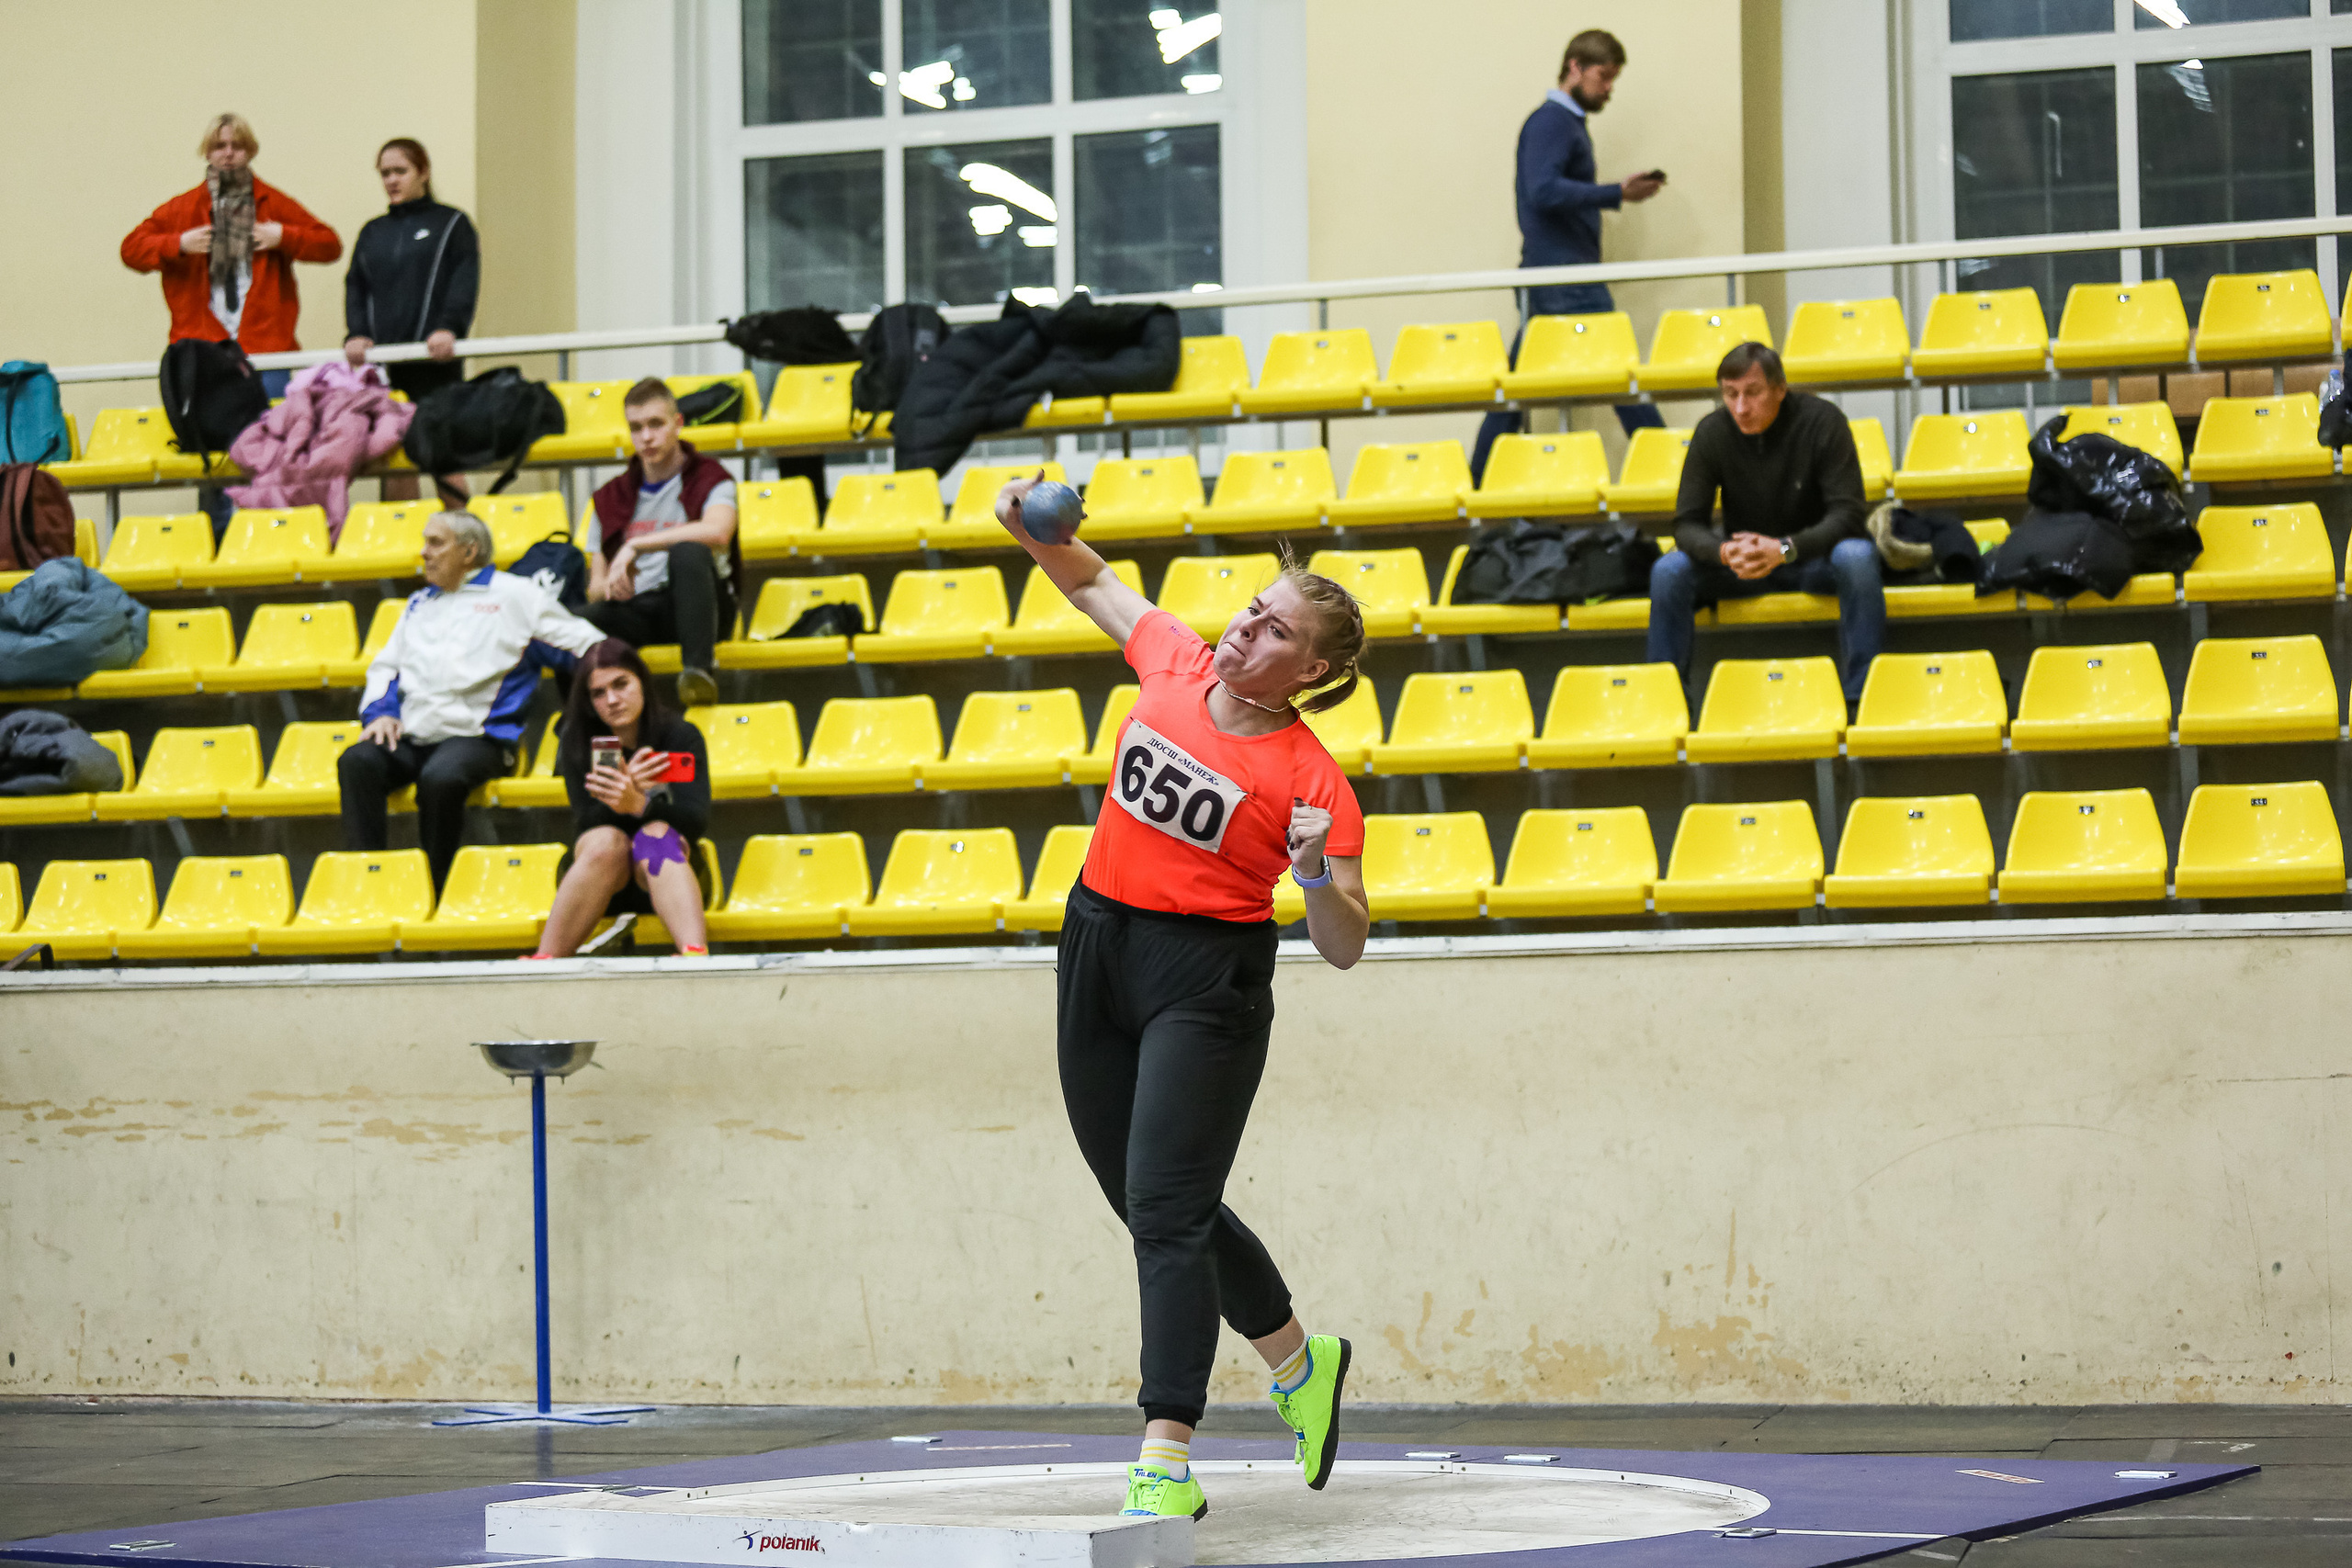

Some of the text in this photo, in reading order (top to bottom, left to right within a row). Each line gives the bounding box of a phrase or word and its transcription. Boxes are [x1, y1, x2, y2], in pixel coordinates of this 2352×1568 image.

[1147, 737, 1178, 760] ДЮСШ
[1121, 745, 1225, 841] 650
[759, 1534, 820, 1552] polanik
